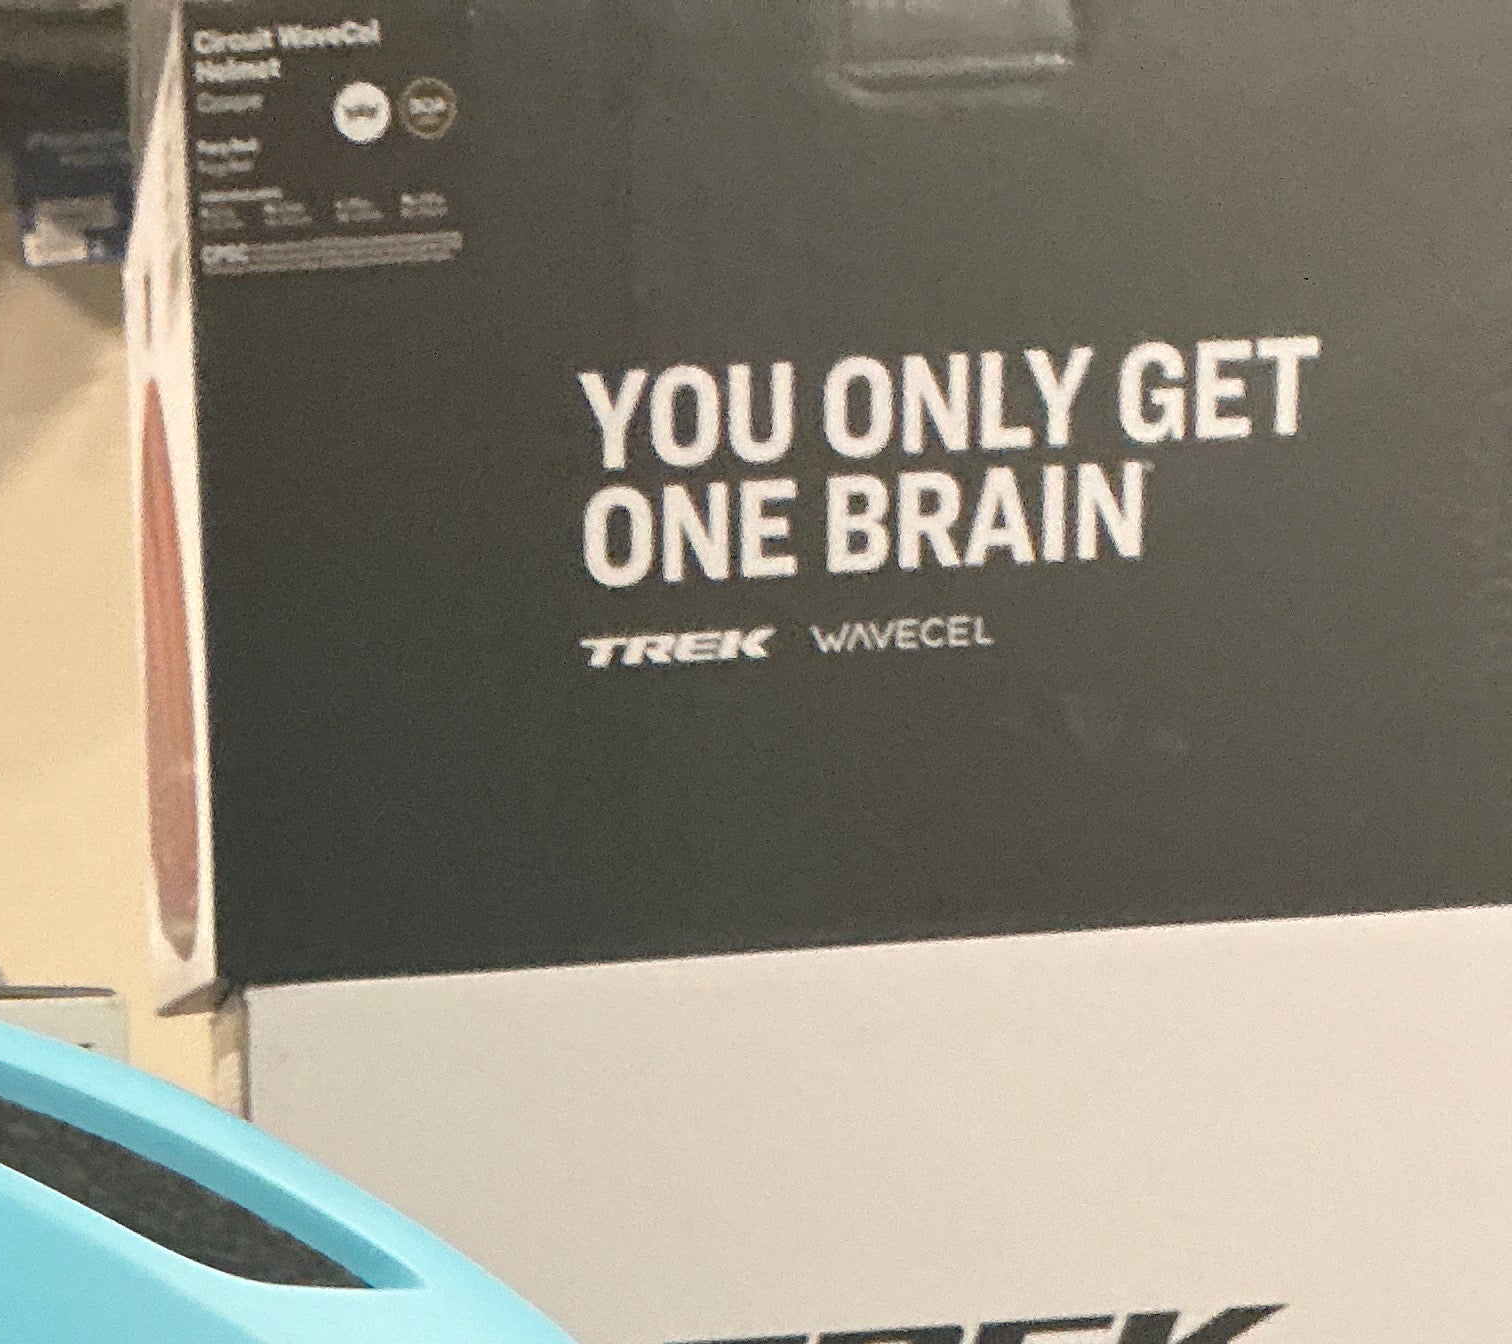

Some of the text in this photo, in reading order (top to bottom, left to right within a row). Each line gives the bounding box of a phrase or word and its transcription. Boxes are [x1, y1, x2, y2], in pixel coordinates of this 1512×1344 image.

[578, 335, 1321, 470] YOU ONLY GET
[583, 459, 1146, 588] ONE BRAIN
[579, 614, 995, 667] TREK WAVECEL
